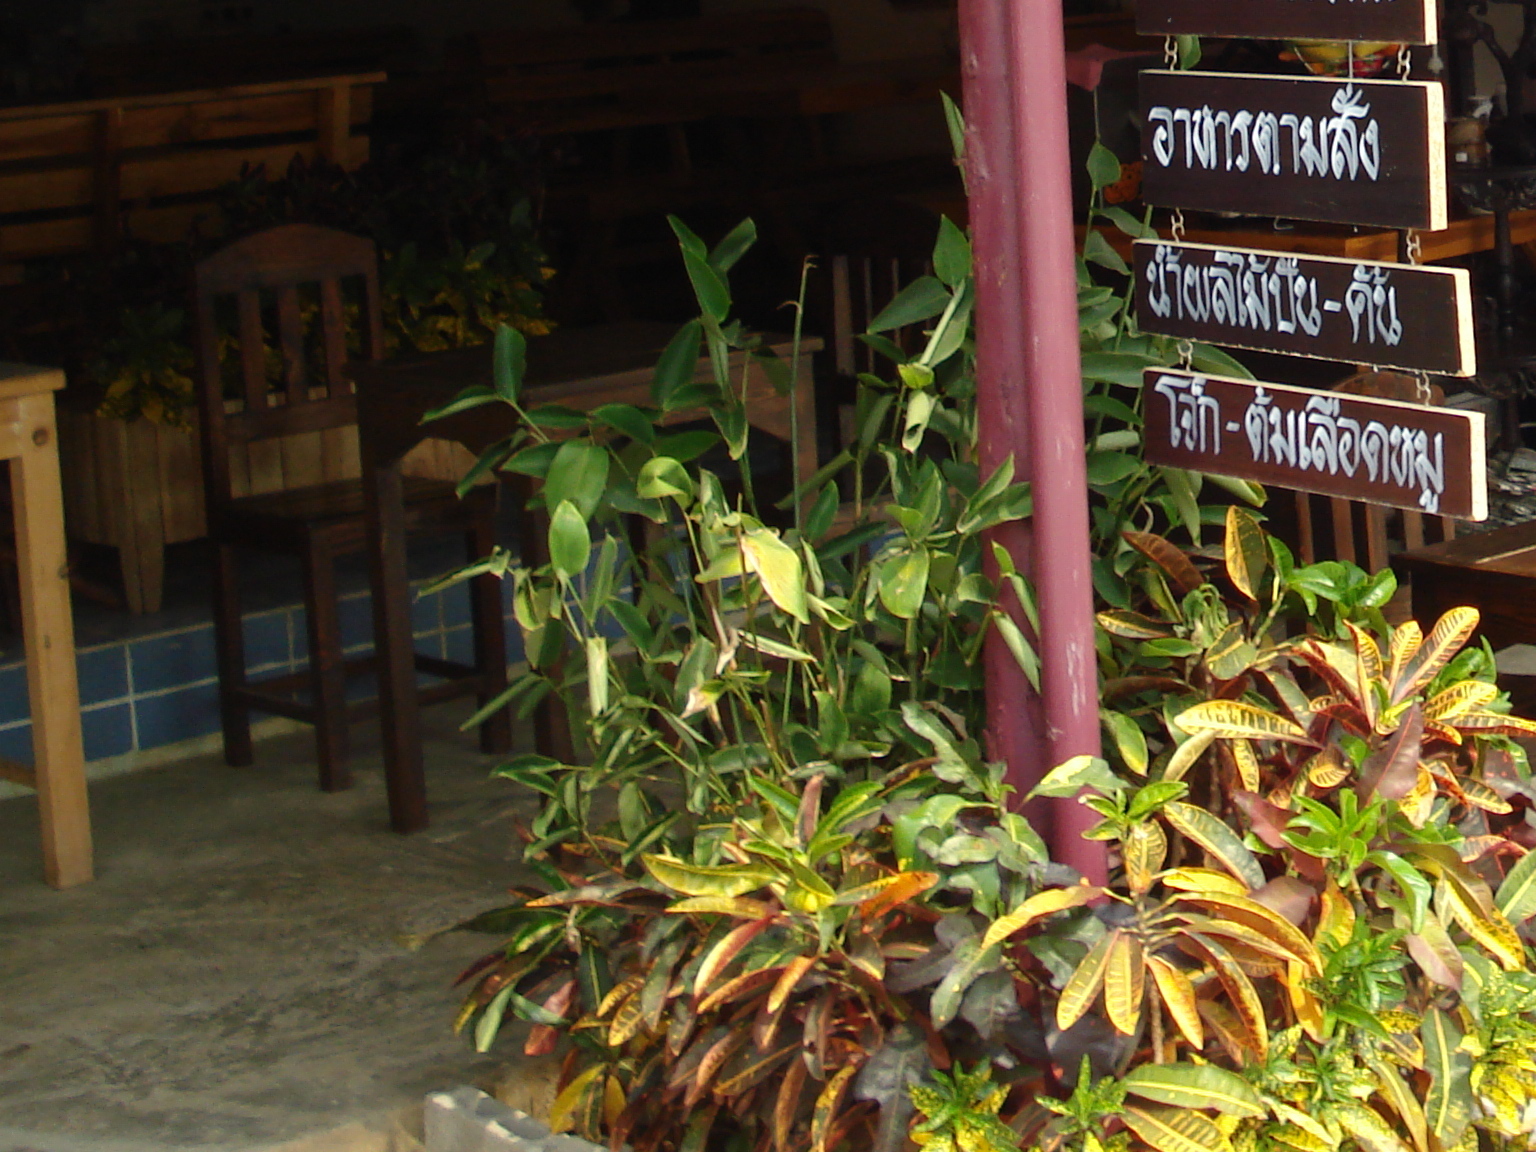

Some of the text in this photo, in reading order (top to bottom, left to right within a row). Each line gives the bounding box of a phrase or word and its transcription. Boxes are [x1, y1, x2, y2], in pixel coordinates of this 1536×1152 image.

[1147, 83, 1380, 182] อาหารตามสั่ง
